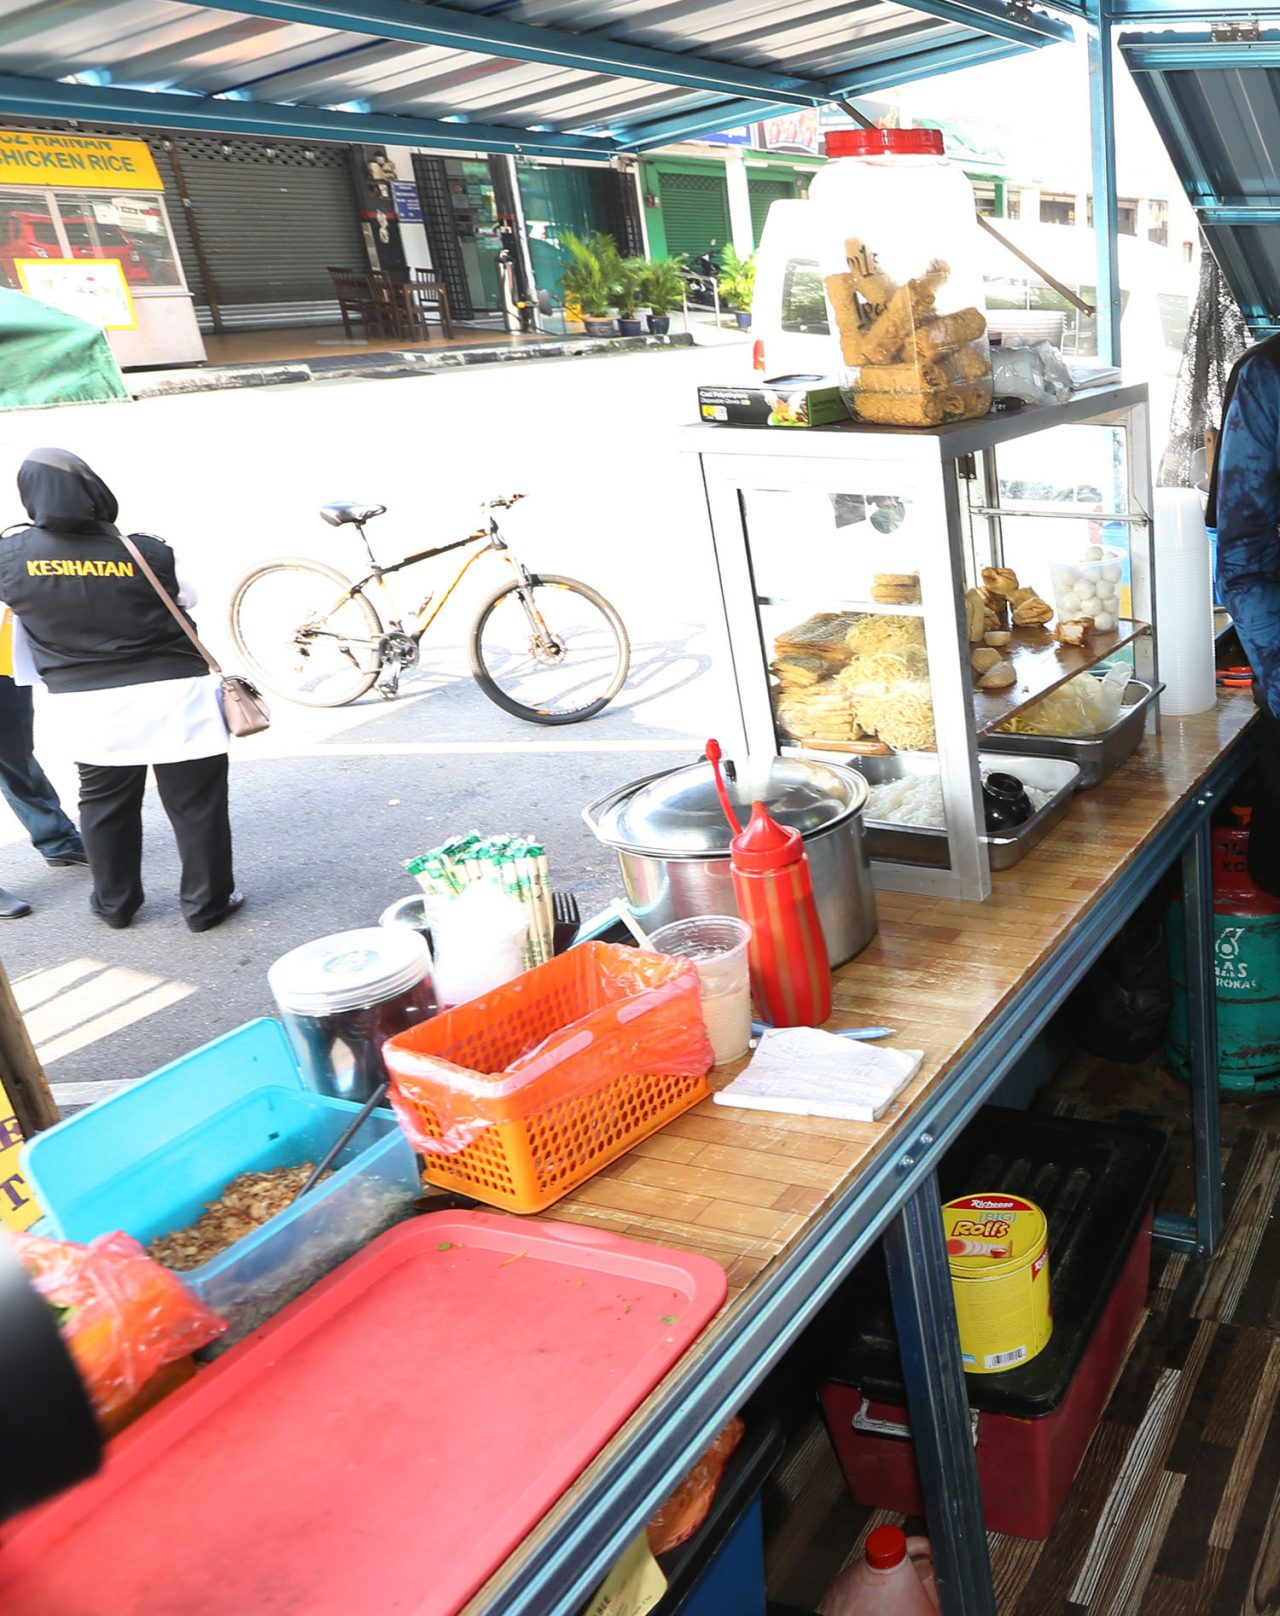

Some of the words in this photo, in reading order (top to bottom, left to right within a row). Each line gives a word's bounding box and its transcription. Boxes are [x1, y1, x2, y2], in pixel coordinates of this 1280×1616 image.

[0, 149, 87, 170] HICKEN
[86, 154, 136, 172] RICE
[26, 559, 134, 577] KESIHATAN
